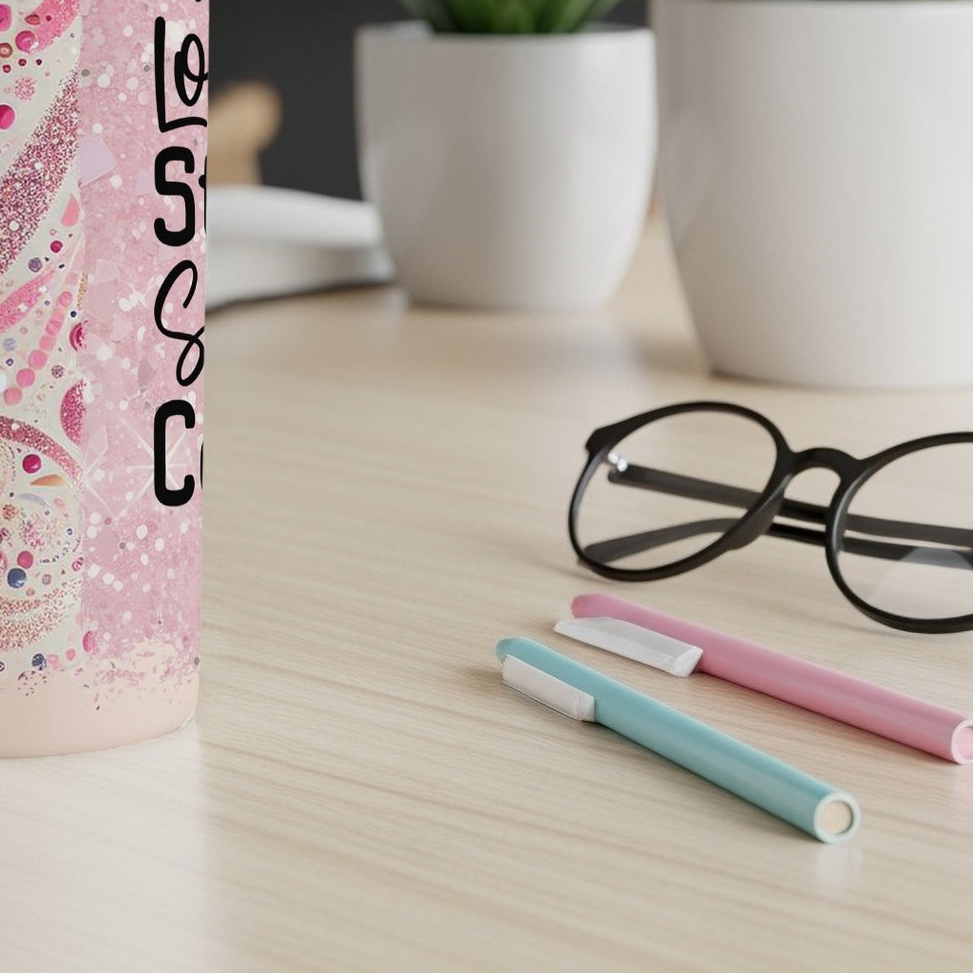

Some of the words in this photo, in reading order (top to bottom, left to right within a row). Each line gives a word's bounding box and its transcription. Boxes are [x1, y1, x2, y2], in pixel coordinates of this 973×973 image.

[154, 16, 209, 133] Lo
[154, 146, 207, 247] S
[154, 259, 205, 387] S
[154, 399, 203, 507] C
